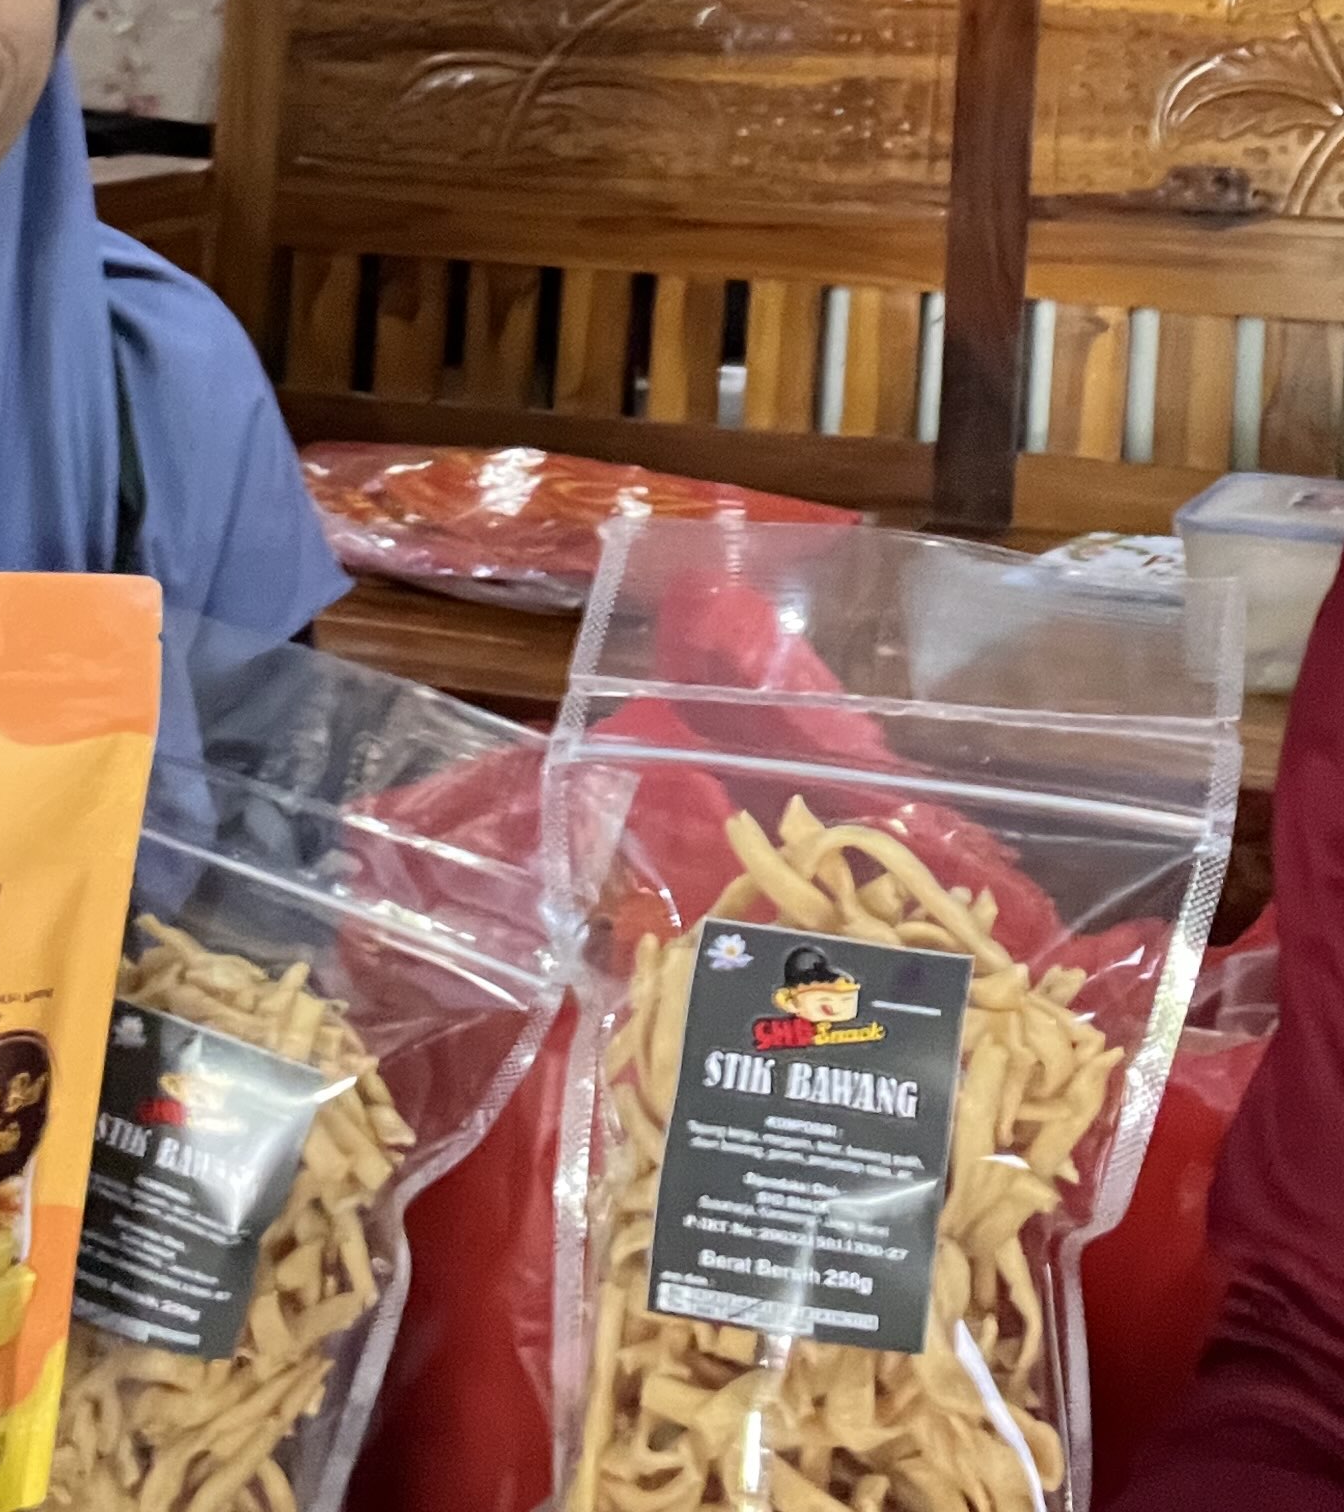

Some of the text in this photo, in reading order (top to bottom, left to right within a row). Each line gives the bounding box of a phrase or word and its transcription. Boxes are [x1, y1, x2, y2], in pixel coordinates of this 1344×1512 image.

[702, 1050, 919, 1119] STIK BAWANG
[698, 1249, 752, 1275] Berat
[823, 1268, 874, 1296] 250g
